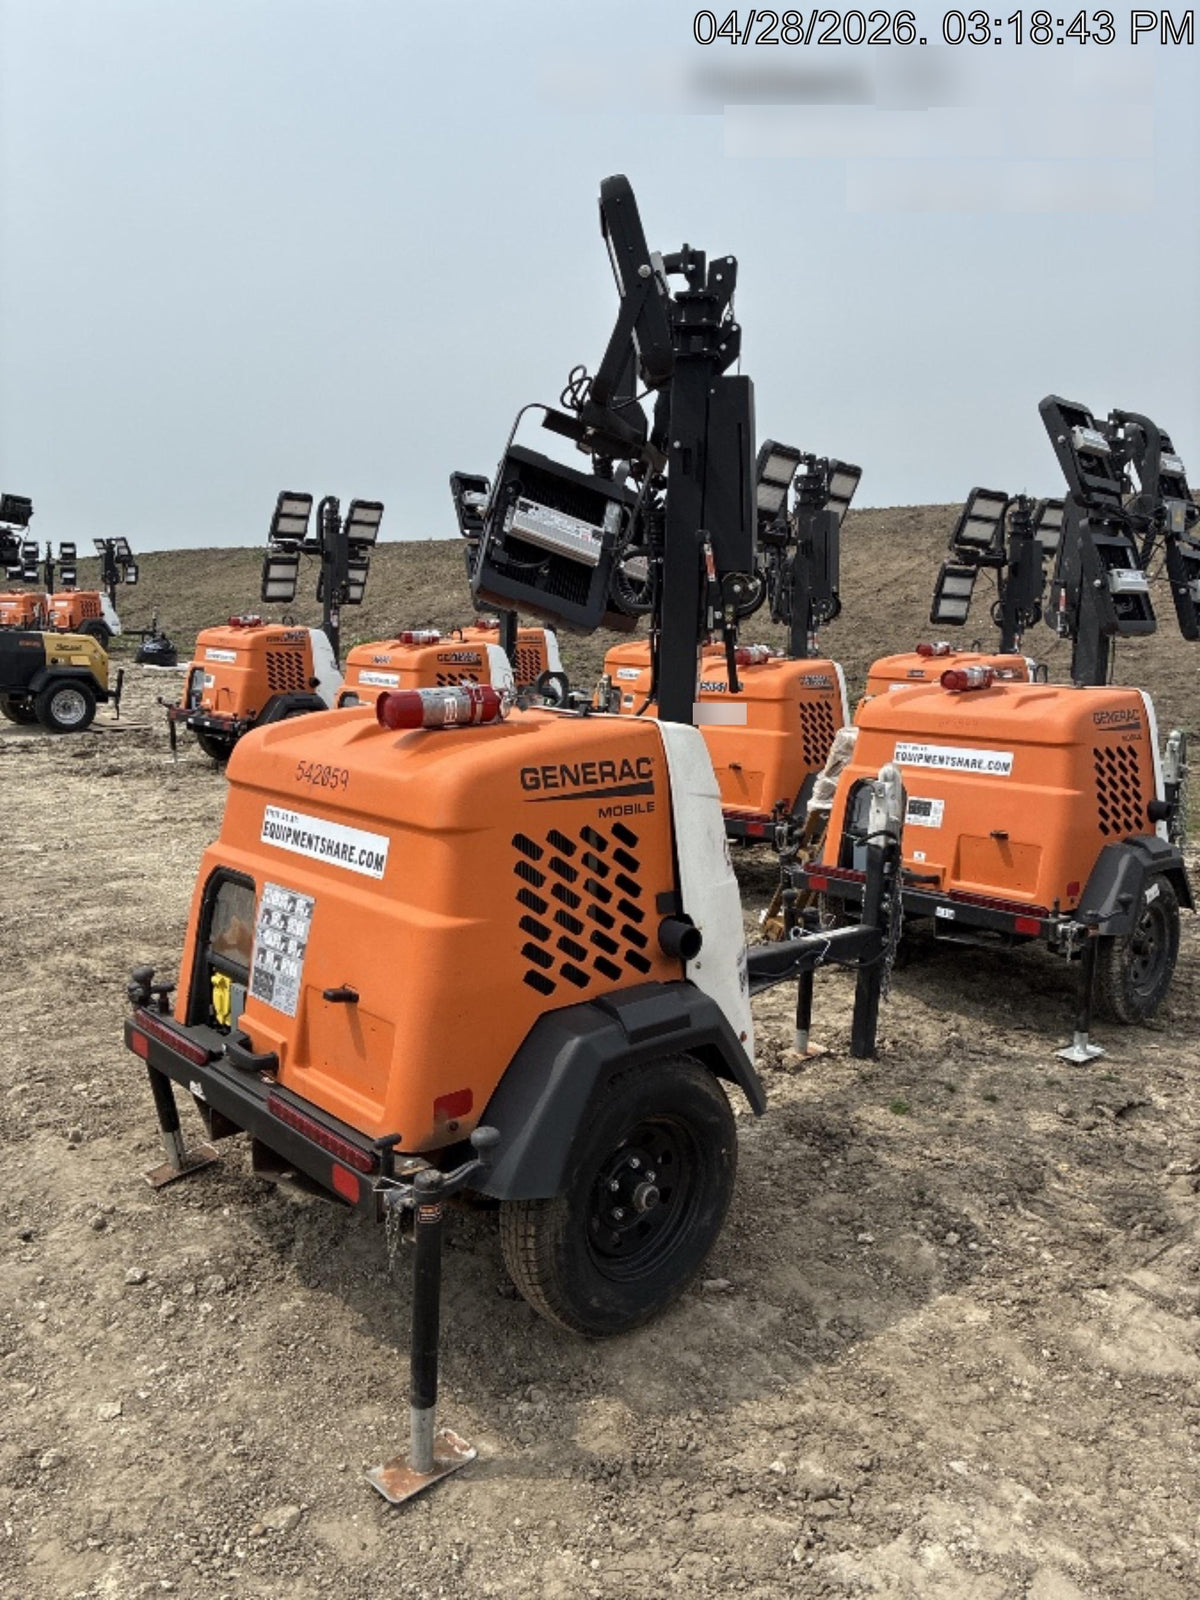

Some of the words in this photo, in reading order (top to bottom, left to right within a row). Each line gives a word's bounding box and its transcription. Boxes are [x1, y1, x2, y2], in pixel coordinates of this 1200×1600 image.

[519, 756, 654, 792] GENERAC
[597, 801, 656, 819] MOBILE
[261, 820, 385, 873] EQUIPMENTSHARE.COM
